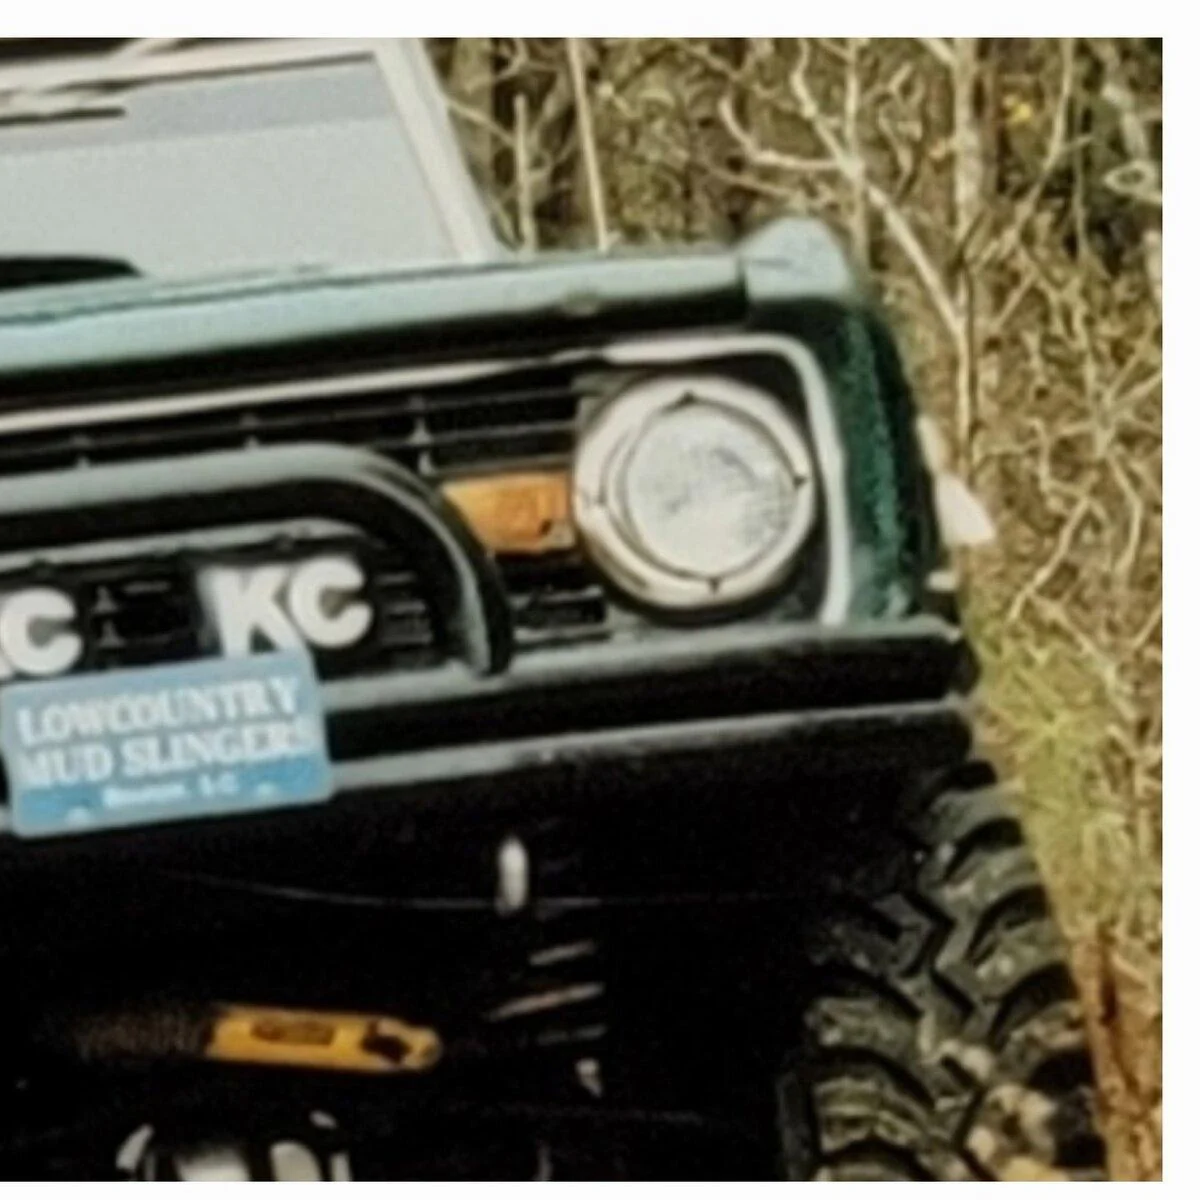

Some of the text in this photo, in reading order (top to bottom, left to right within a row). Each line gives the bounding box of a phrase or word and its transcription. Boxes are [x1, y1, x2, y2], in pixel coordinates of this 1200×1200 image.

[204, 556, 373, 657] KC
[16, 675, 299, 747] LOWCOUNTRY
[18, 743, 114, 787] MUD
